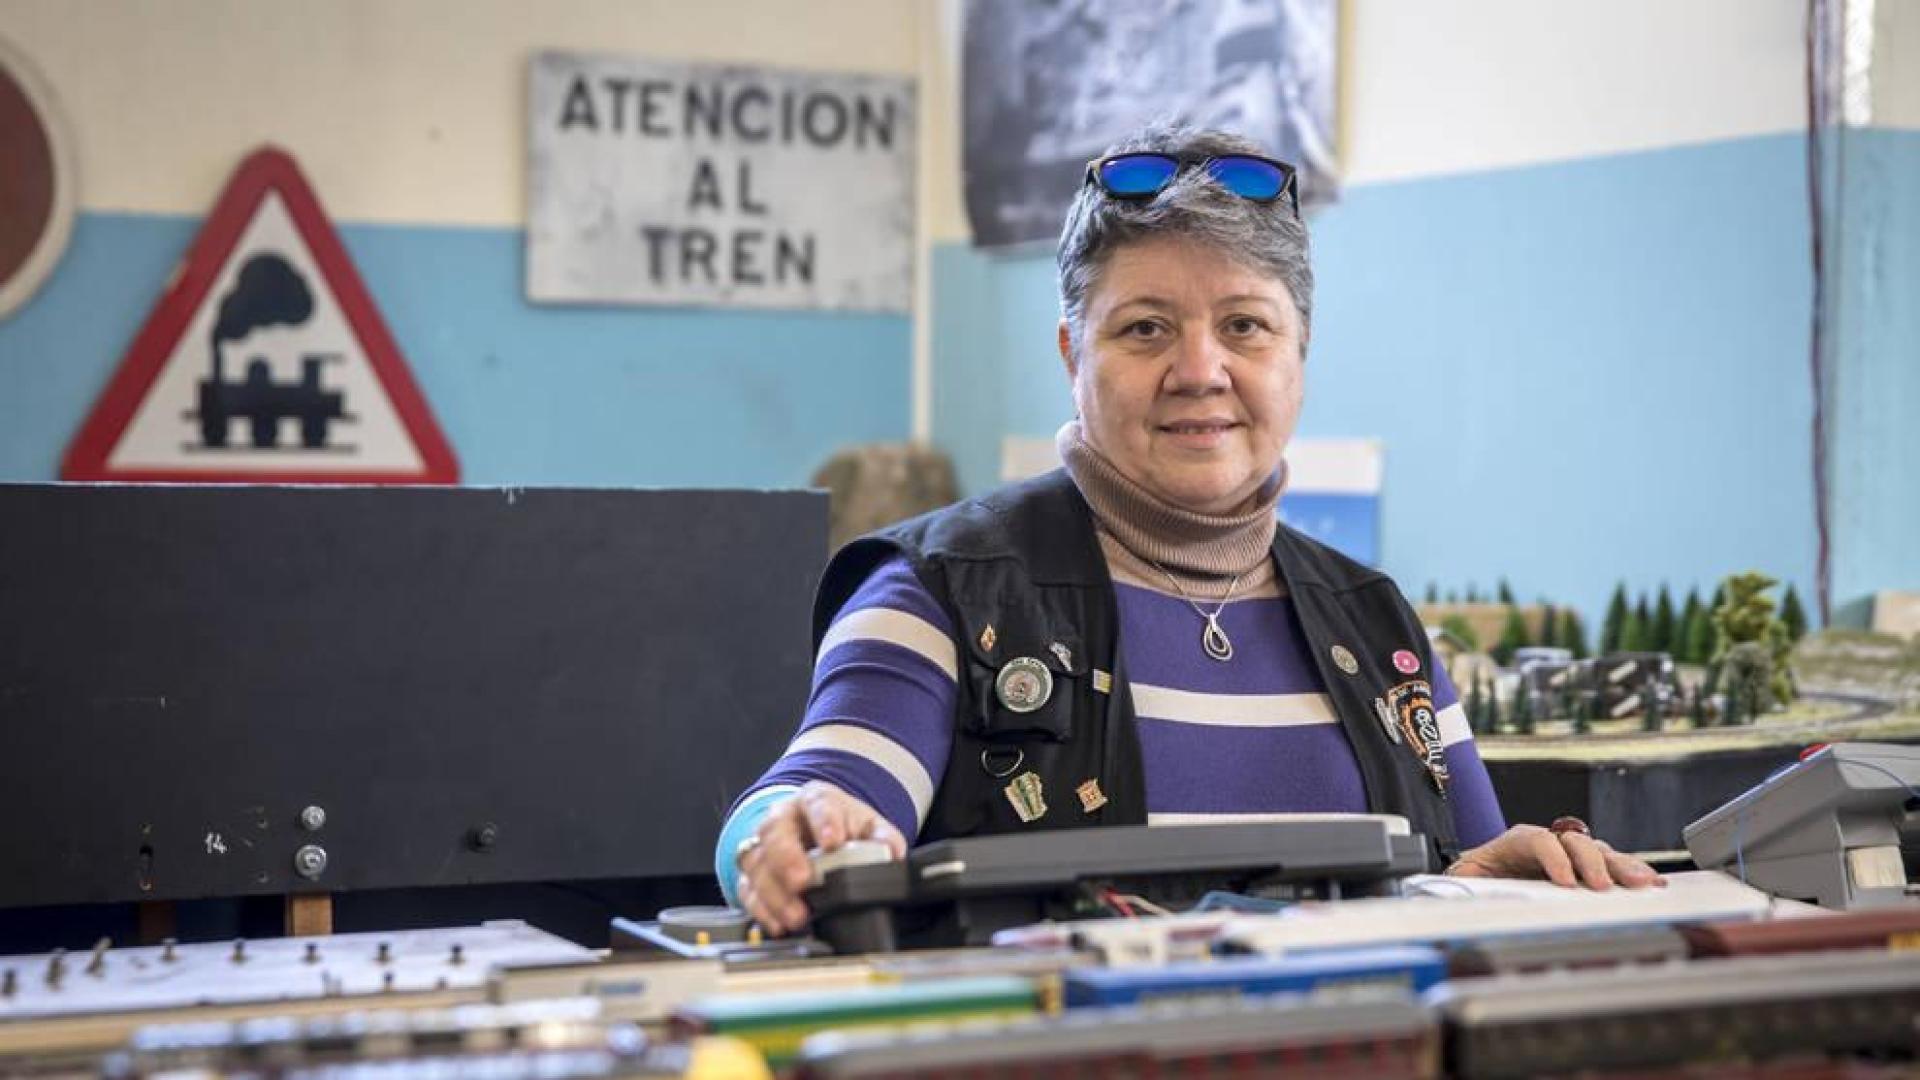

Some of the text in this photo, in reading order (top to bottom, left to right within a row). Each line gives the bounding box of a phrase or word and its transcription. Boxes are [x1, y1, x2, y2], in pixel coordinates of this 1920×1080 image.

[559, 74, 895, 148] ATENCION
[687, 157, 767, 215] AL
[641, 226, 815, 285] TREN
[205, 832, 228, 854] 14
